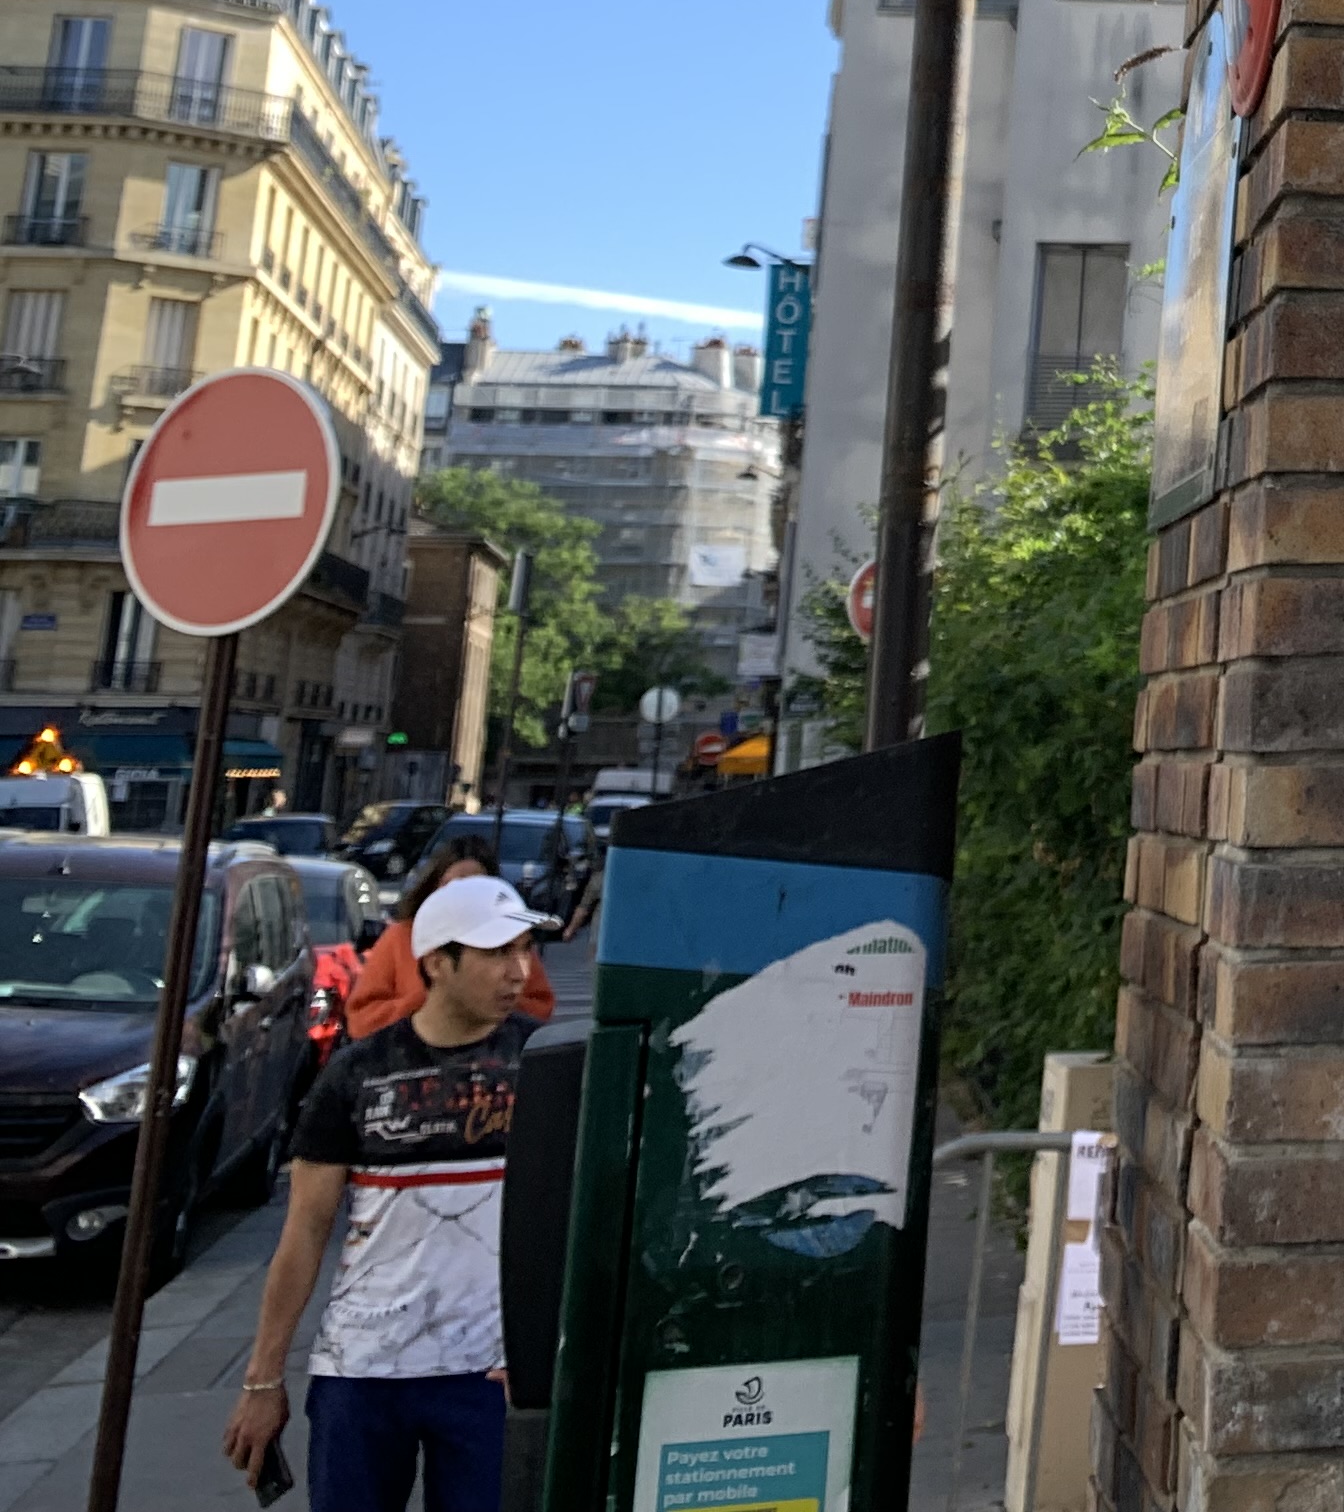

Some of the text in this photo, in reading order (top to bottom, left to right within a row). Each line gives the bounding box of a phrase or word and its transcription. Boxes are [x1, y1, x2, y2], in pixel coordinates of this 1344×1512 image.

[771, 267, 803, 416] HÔTEL
[847, 991, 914, 1007] Maindron
[722, 1411, 773, 1428] PARIS
[667, 1445, 769, 1467] Payez votre
[664, 1462, 796, 1485] stationnement
[663, 1484, 759, 1509] par mobile
